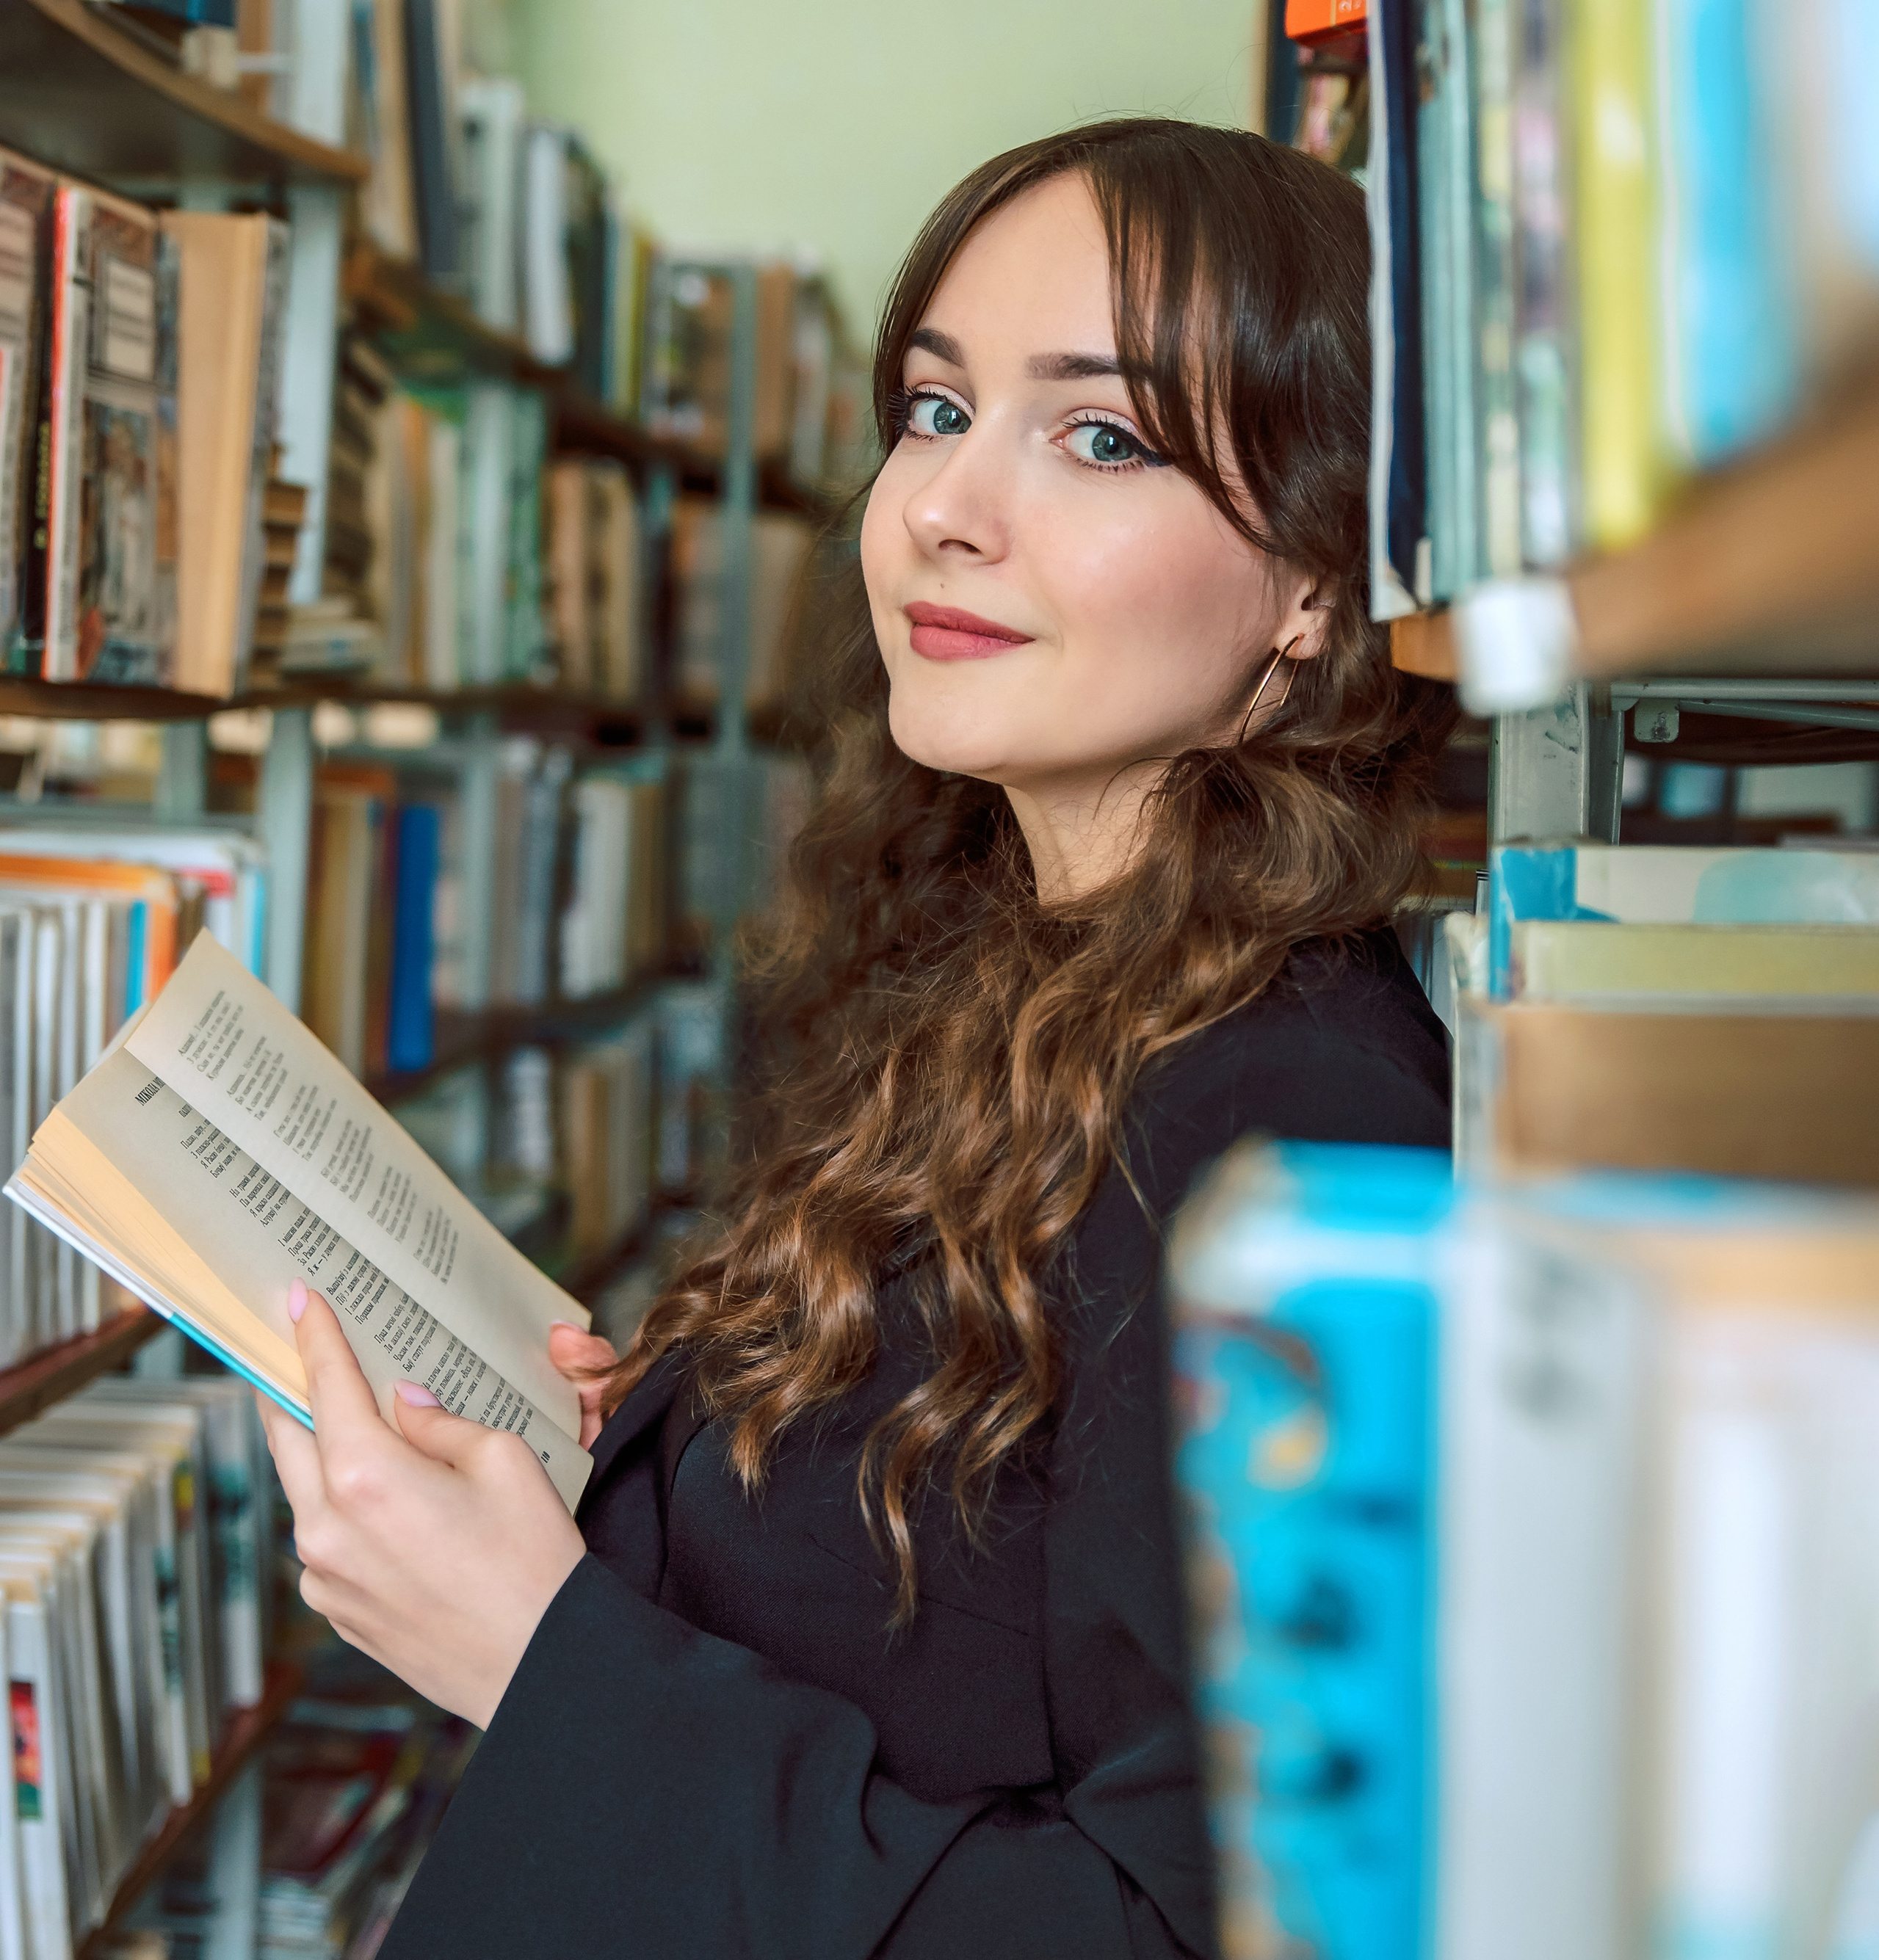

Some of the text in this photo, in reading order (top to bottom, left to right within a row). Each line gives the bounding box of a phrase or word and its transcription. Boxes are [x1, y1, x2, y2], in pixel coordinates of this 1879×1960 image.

[134, 1083, 160, 1106] МІКОЛА
[229, 1188, 240, 1198] На
[239, 1198, 250, 1208] Па
[297, 1258, 307, 1266] За
[335, 1292, 347, 1306] Піў
[374, 1329, 388, 1344] Прад
[383, 1343, 394, 1354] Ля
[433, 1387, 443, 1400] уду
[540, 1451, 550, 1463] 110
